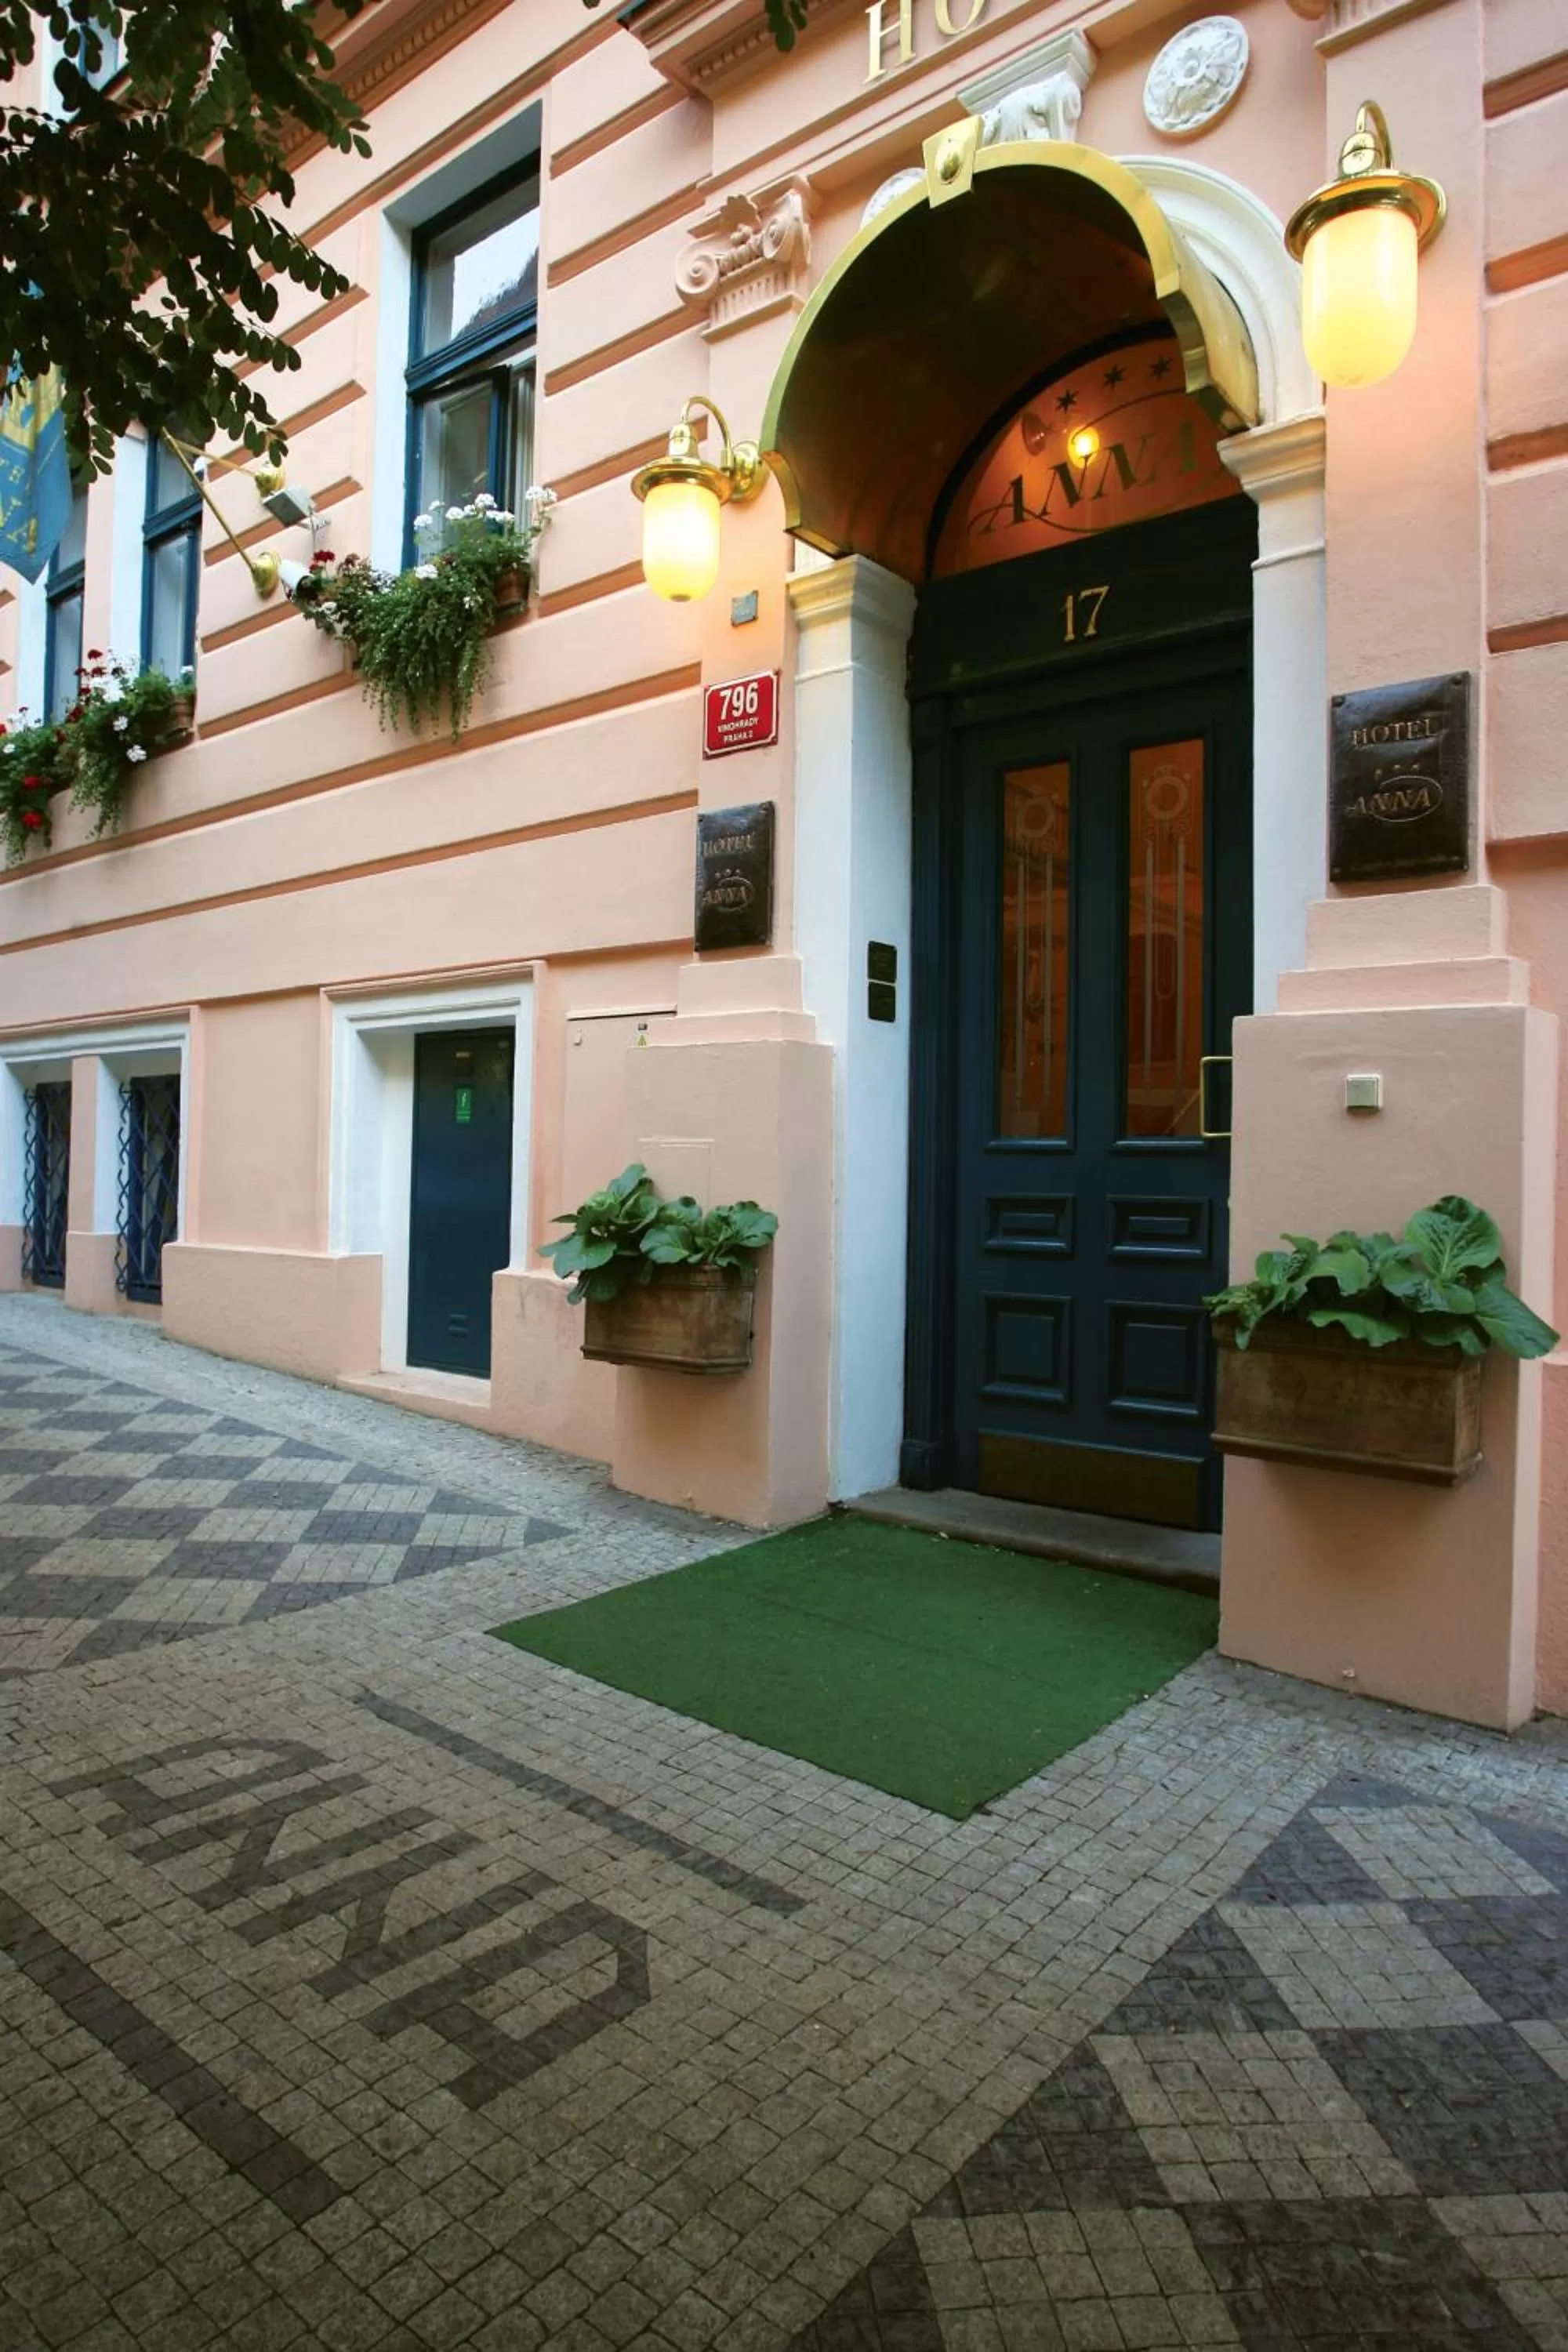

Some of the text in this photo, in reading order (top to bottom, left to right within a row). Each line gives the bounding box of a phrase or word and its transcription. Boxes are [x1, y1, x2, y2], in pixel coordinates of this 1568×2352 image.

[977, 418, 1200, 535] ANNA
[1059, 585, 1110, 643] 17
[719, 681, 759, 720] 796
[717, 717, 759, 733] VINOHRADY
[1351, 718, 1438, 746] HOTEL
[1344, 786, 1432, 817] ANNA
[702, 833, 755, 856] HOTEL
[702, 885, 749, 905] ANNA
[49, 1736, 652, 2112] ANNA
